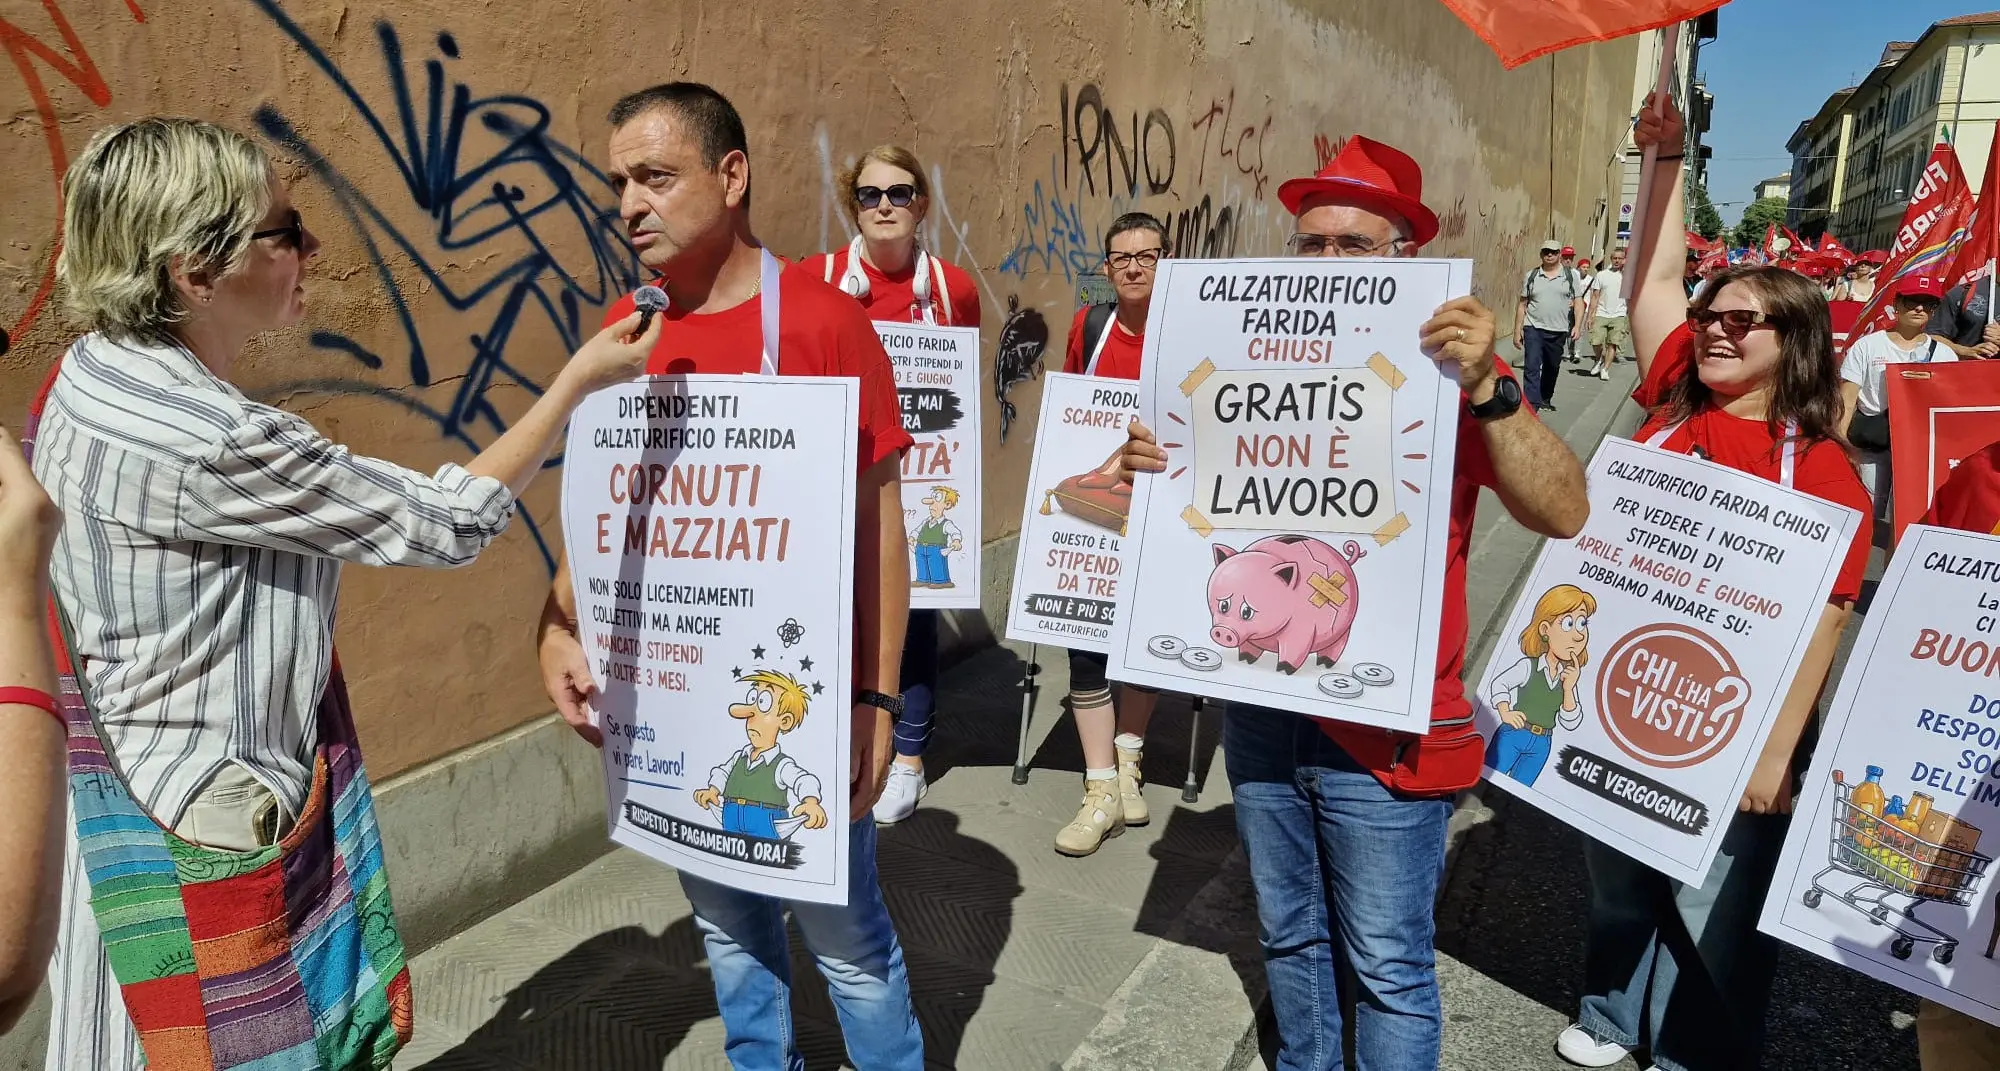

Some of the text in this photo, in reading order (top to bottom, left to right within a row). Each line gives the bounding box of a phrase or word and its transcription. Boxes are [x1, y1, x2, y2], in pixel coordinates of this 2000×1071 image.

[1199, 275, 1396, 305] CALZATURIFICIO
[1242, 308, 1337, 336] FARIDA
[880, 334, 957, 352] FICIO FARIDA
[1247, 337, 1332, 363] CHIUSI
[907, 372, 912, 383] E
[917, 372, 953, 385] GIUGNO
[914, 357, 951, 369] STIPENDI
[954, 360, 963, 370] DI
[619, 395, 739, 419] DIPENDENTI
[917, 395, 943, 411] MAI
[1062, 407, 1123, 429] SCARPE
[901, 413, 922, 429] RA
[594, 427, 796, 450] CALZATURIFICIO FARIDA
[1235, 426, 1350, 469] NON È
[609, 463, 761, 508] CORNUTI
[1211, 475, 1379, 518] LAVORO
[1607, 460, 1831, 543] CALZATURIFICIO FARIDA CHIUSI
[597, 513, 791, 562] E MAZZIATI
[1052, 531, 1120, 551] QUESTO È IL
[1613, 496, 1785, 565] PER VEDERE I NOSTRI
[1626, 527, 1724, 572] STIPENDI DI
[1057, 573, 1117, 597] DA TRE
[1575, 534, 1782, 620] APRILE, MAGGIO E GIUGNO
[589, 577, 754, 608] NON SOLO LICENZIAMENTI
[1579, 561, 1752, 636] DOBBIAMO ANDARE SU:
[1977, 592, 1999, 611] La
[593, 605, 721, 637] COLLETTIVI MA ANCHE
[1035, 598, 1062, 614] NON
[1065, 599, 1075, 615] È
[1077, 602, 1098, 618] PIÙ
[1038, 620, 1108, 638] CALZATURIFICIO
[1976, 616, 1996, 633] CI
[596, 632, 703, 666] MANCATO STIPENDI
[599, 658, 691, 693] DA OLTRE 3 MESI.
[1627, 648, 1678, 692] CHI
[606, 714, 656, 743] Se questo
[613, 747, 685, 777] vi pare Lavoro!
[1569, 756, 1700, 828] CHE VERGOGNA!
[632, 805, 787, 864] RISPETTO E PAGAMENTO, ORA!
